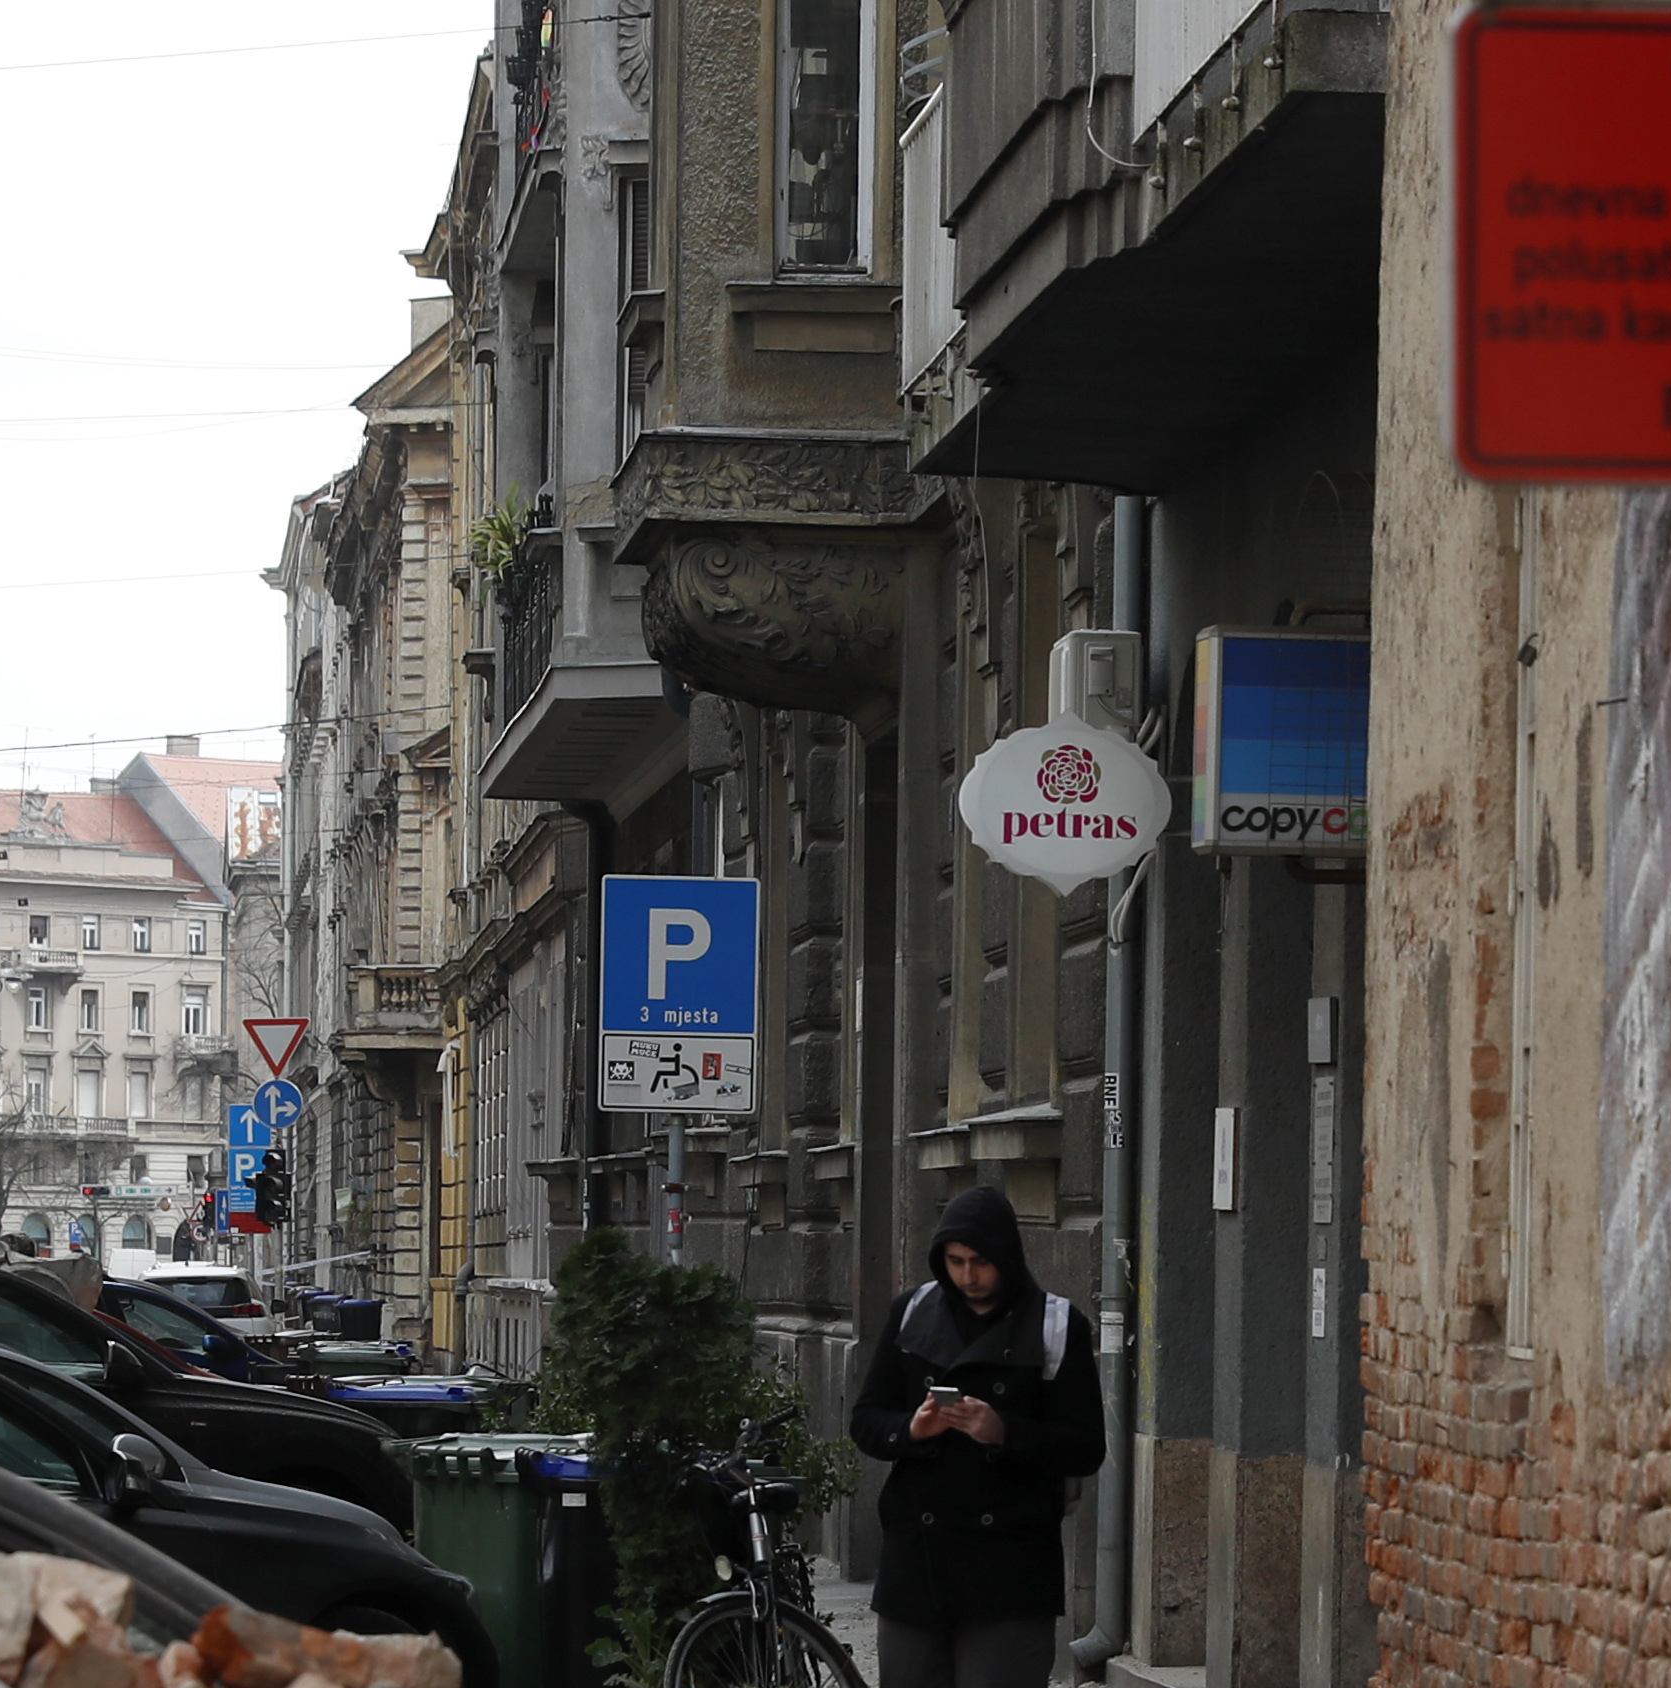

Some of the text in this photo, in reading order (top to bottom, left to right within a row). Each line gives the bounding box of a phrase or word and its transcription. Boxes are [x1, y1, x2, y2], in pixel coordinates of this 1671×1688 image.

[1507, 175, 1668, 220] dnevna
[1484, 298, 1606, 343] satna
[1001, 807, 1137, 844] petras
[648, 908, 711, 999] P
[640, 1006, 718, 1027] 3 mjesta
[235, 1153, 255, 1182] P
